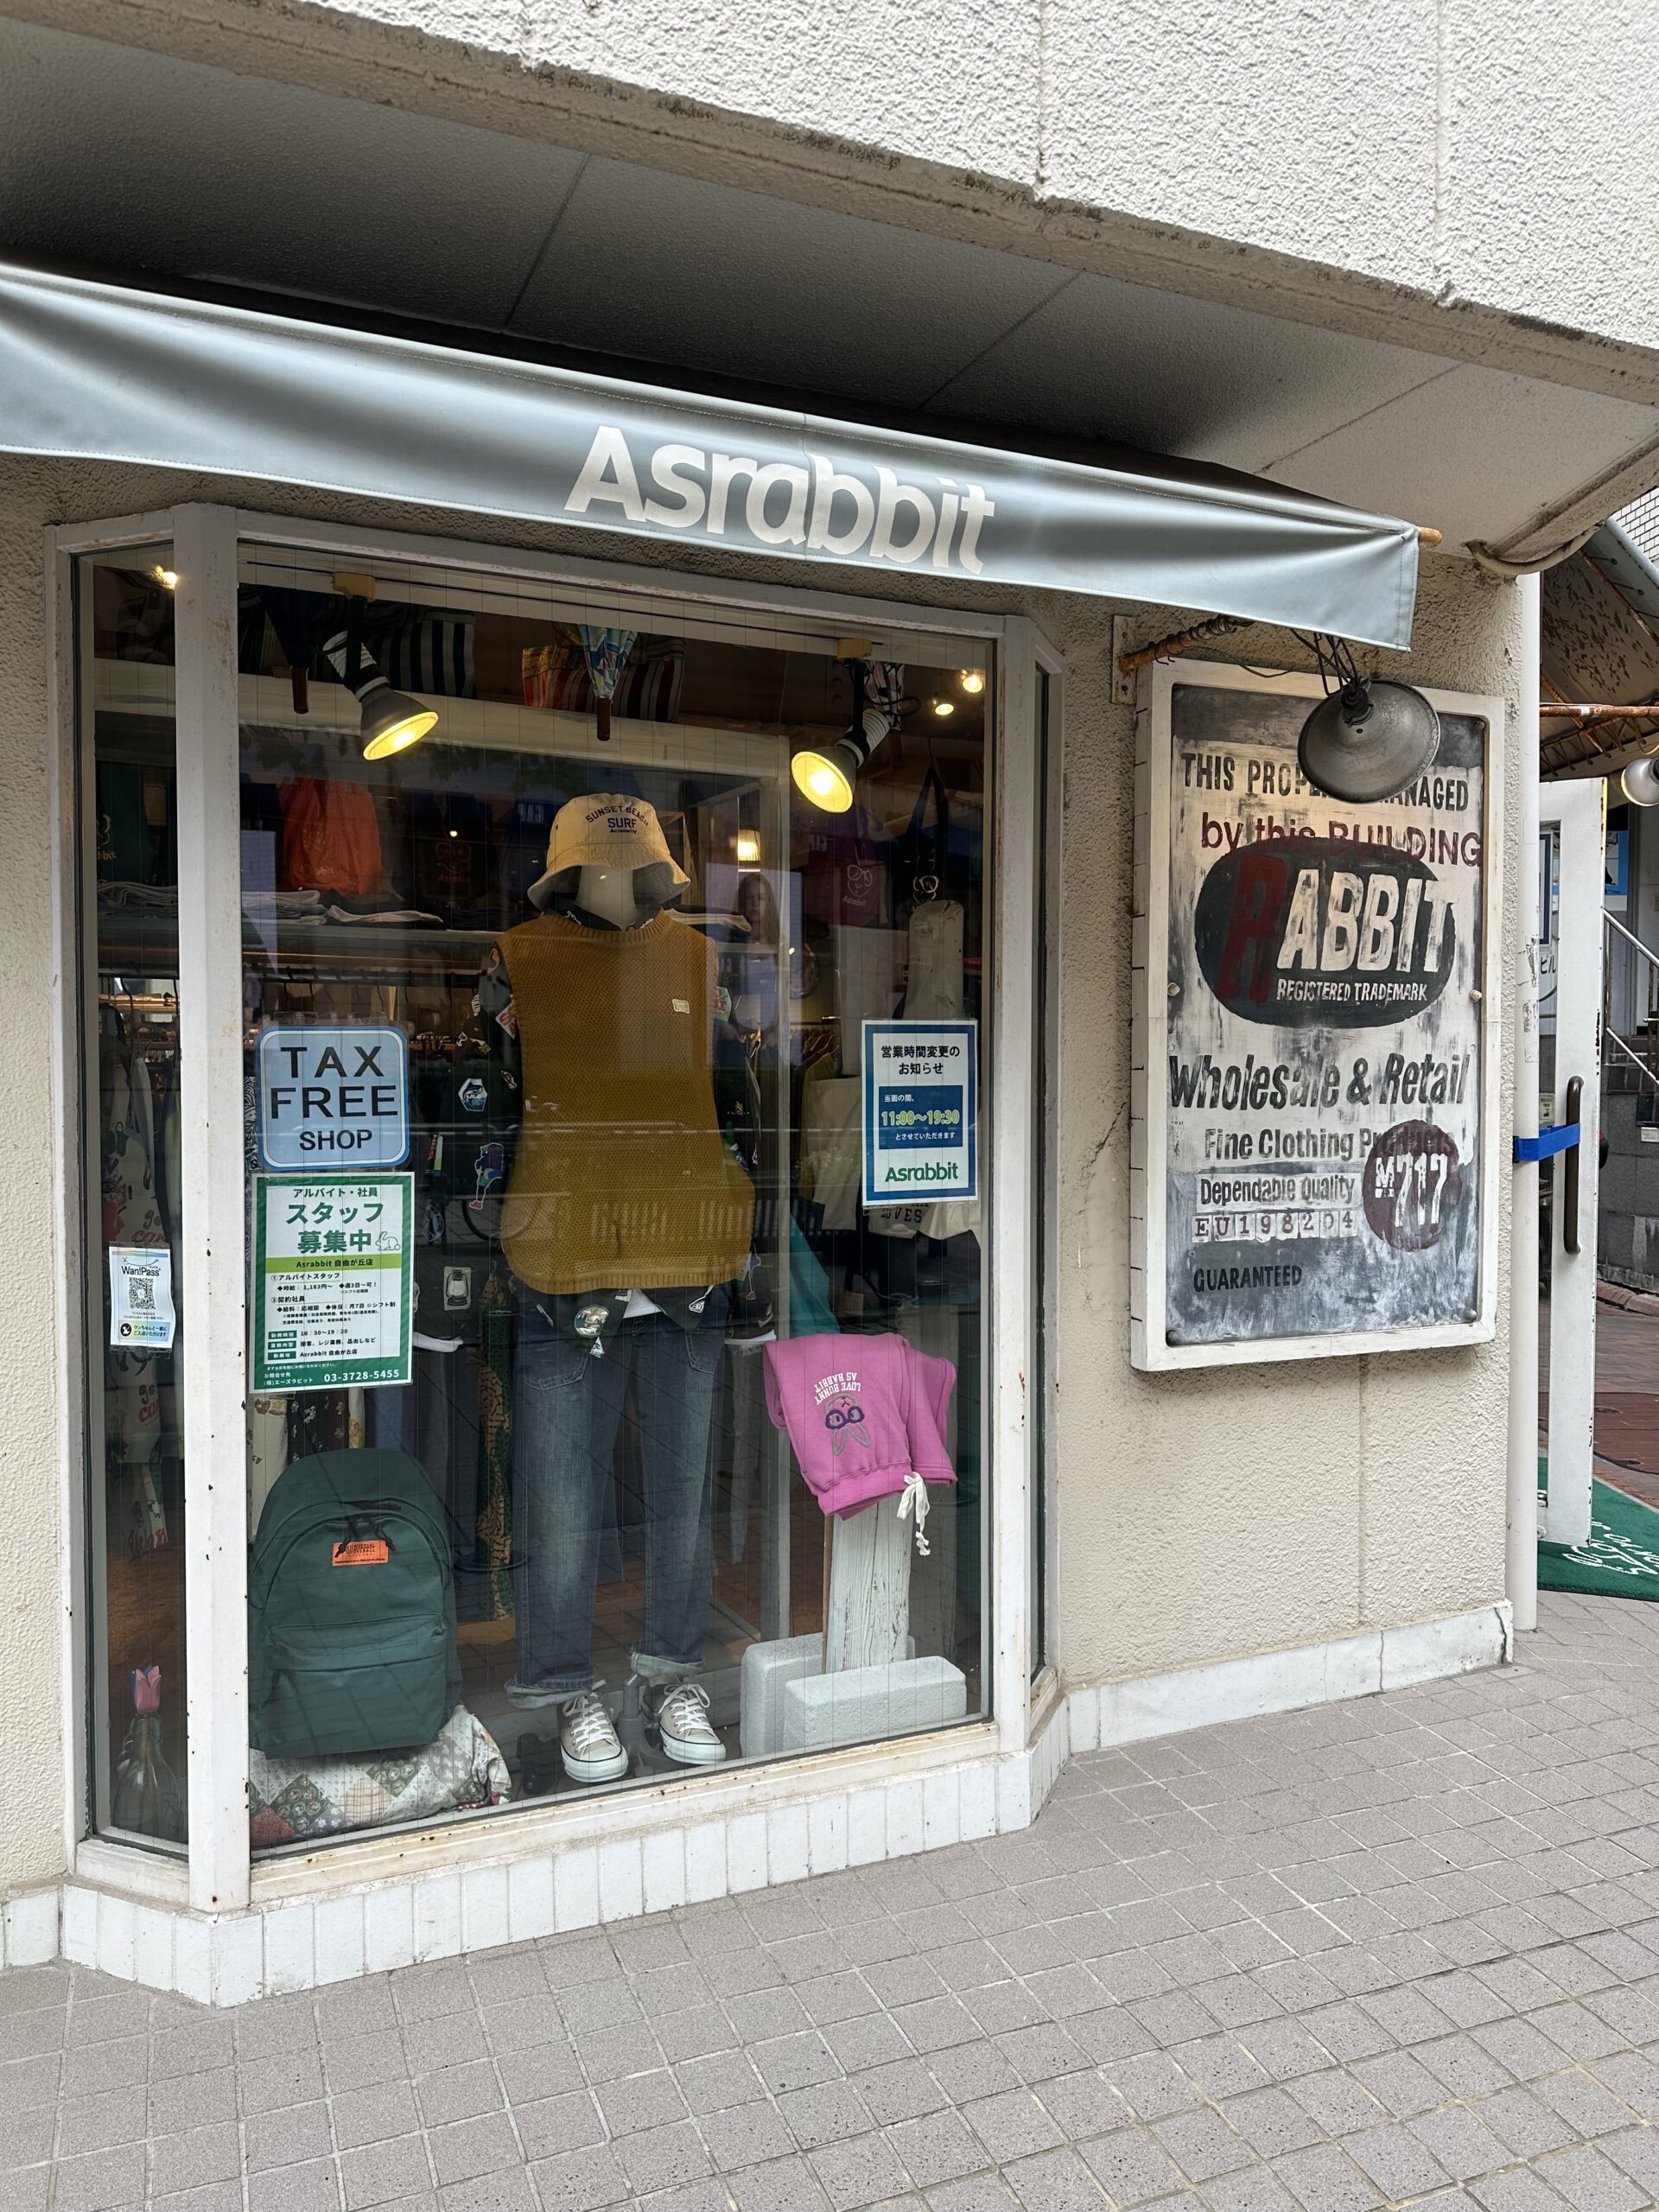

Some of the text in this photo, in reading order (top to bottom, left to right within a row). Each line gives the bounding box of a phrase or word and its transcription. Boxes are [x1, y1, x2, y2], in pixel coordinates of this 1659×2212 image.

[564, 425, 995, 575] Asrabbit
[1181, 753, 1236, 791] THIS
[585, 805, 622, 823] SUNSET
[607, 817, 638, 829] SURF
[1202, 811, 1482, 868] by this BUILDING
[1216, 854, 1458, 1003] RABBIT
[1276, 978, 1428, 1003] REGISTERED TRADEMARK
[280, 1046, 385, 1078] TAX
[881, 1046, 960, 1058] 営業時間変更の
[899, 1062, 944, 1075] お知らせ
[1169, 1052, 1471, 1110] Wholesale & Retail
[270, 1085, 398, 1119] FREE
[884, 1094, 914, 1103] 当面の間、
[299, 1129, 372, 1151] SHOP
[895, 1132, 956, 1141] とさせていただきます
[1205, 1128, 1252, 1160] Fine
[1259, 1128, 1353, 1162] Clothing
[885, 1161, 958, 1183] Asrabbit
[293, 1187, 378, 1198] アルバイト・社員
[1200, 1176, 1295, 1205] Dependable
[286, 1202, 385, 1224] スタッフ
[297, 1229, 372, 1255] 募集中
[121, 1265, 161, 1277] Wan!Pass
[296, 1258, 373, 1268] Asrabbit 自由が丘店
[1193, 1265, 1302, 1292] GUARANTEED
[300, 1350, 327, 1358] Asrabbit
[324, 1370, 400, 1382] 03-3728-5455
[813, 1371, 858, 1394] AS RABBIT
[813, 1382, 862, 1405] LOVE BUNNY
